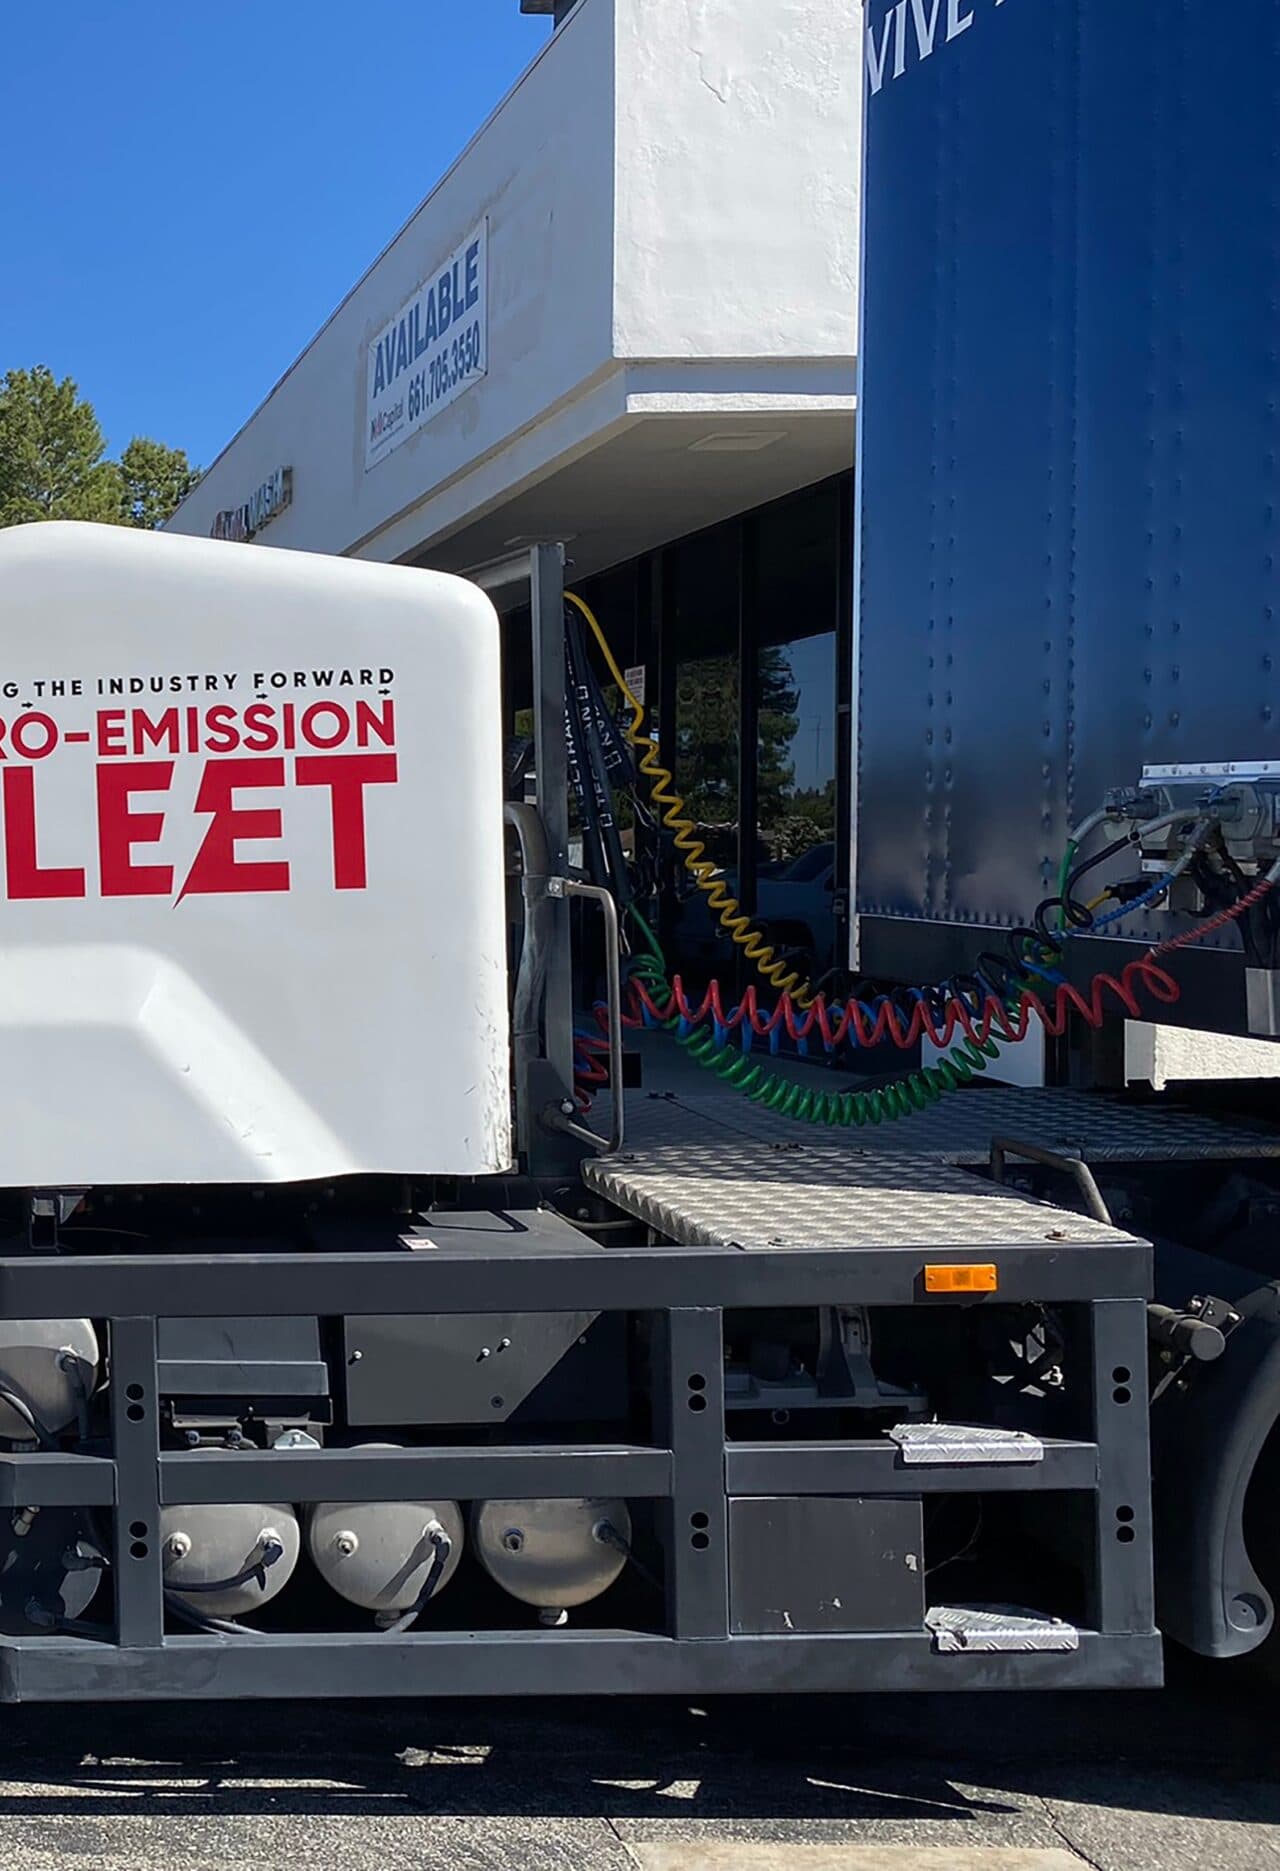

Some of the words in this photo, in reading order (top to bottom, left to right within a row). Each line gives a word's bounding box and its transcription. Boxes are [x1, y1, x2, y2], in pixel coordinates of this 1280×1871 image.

[373, 239, 480, 399] AVAILABLE
[408, 320, 480, 421] 661.705.3550
[34, 680, 83, 697] THE
[98, 674, 238, 694] INDUSTRY
[253, 668, 394, 690] FORWARD
